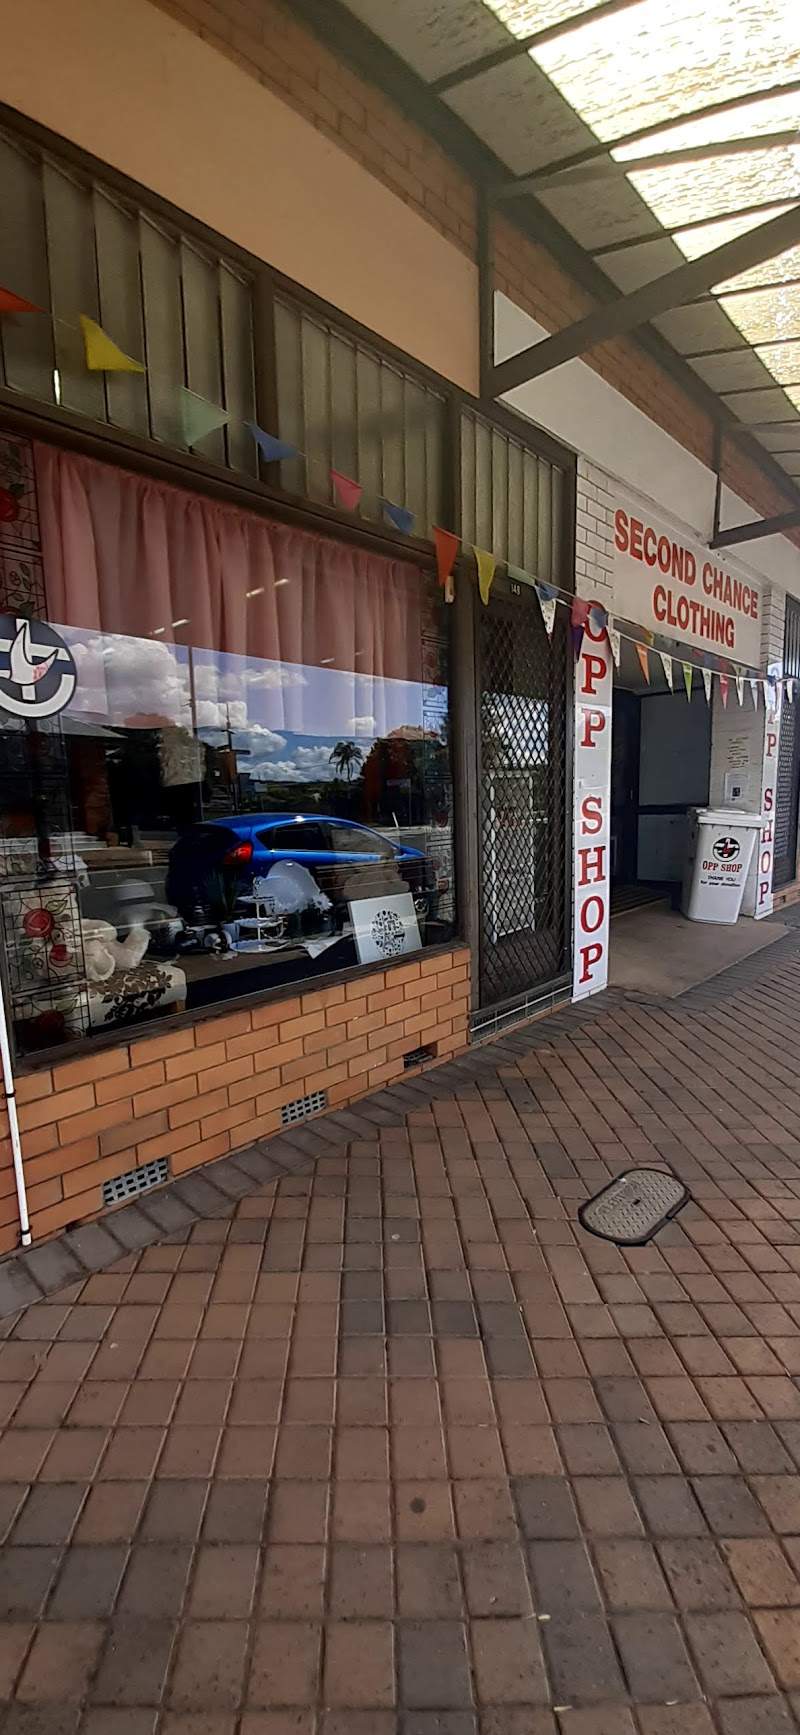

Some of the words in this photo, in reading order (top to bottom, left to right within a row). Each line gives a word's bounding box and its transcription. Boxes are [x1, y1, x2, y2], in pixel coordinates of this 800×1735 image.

[614, 509, 696, 586] SECOND
[702, 562, 759, 620] CHANCE
[653, 584, 735, 649] CLOTHING
[580, 600, 608, 748] OPP
[577, 796, 607, 985] SHOP
[703, 861, 718, 871] OPP
[720, 864, 742, 872] SHOP
[758, 788, 774, 906] SHOP
